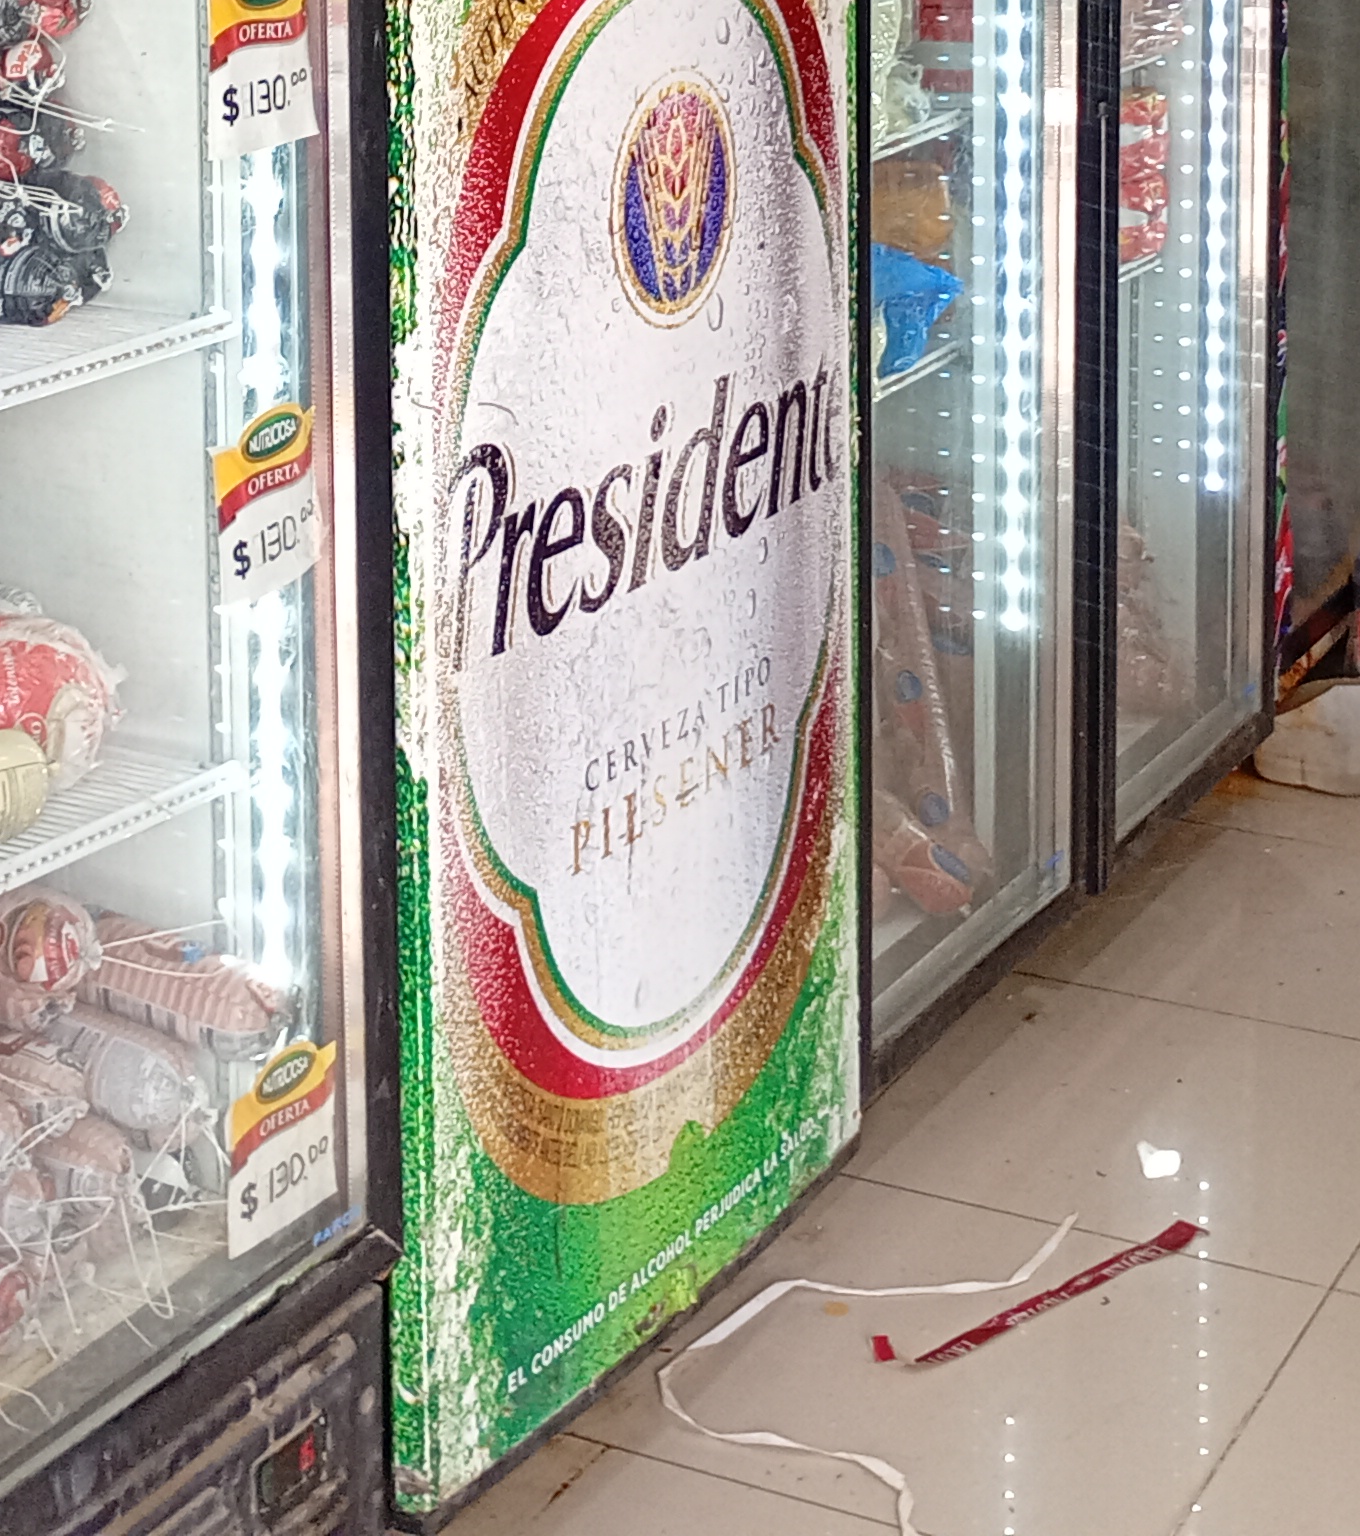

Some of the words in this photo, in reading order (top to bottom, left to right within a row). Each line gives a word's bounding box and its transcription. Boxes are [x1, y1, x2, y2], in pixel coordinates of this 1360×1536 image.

[238, 20, 293, 43] OFERTA
[222, 84, 240, 127] $
[248, 417, 297, 454] NUTRICIOSA
[246, 462, 301, 496] OFERTA
[232, 539, 252, 581] $
[584, 700, 708, 793] CERVEZA
[717, 655, 772, 714] TIPO
[569, 702, 780, 878] PILSENER
[258, 1097, 311, 1138] OFERTA
[240, 1181, 259, 1222] $
[506, 1371, 528, 1394] EL
[531, 1302, 605, 1375] CONSUMO
[607, 1287, 628, 1313] DE
[629, 1233, 693, 1295] ALCOHOL
[695, 1172, 762, 1240] PERJUDICA
[762, 1154, 779, 1179] LA
